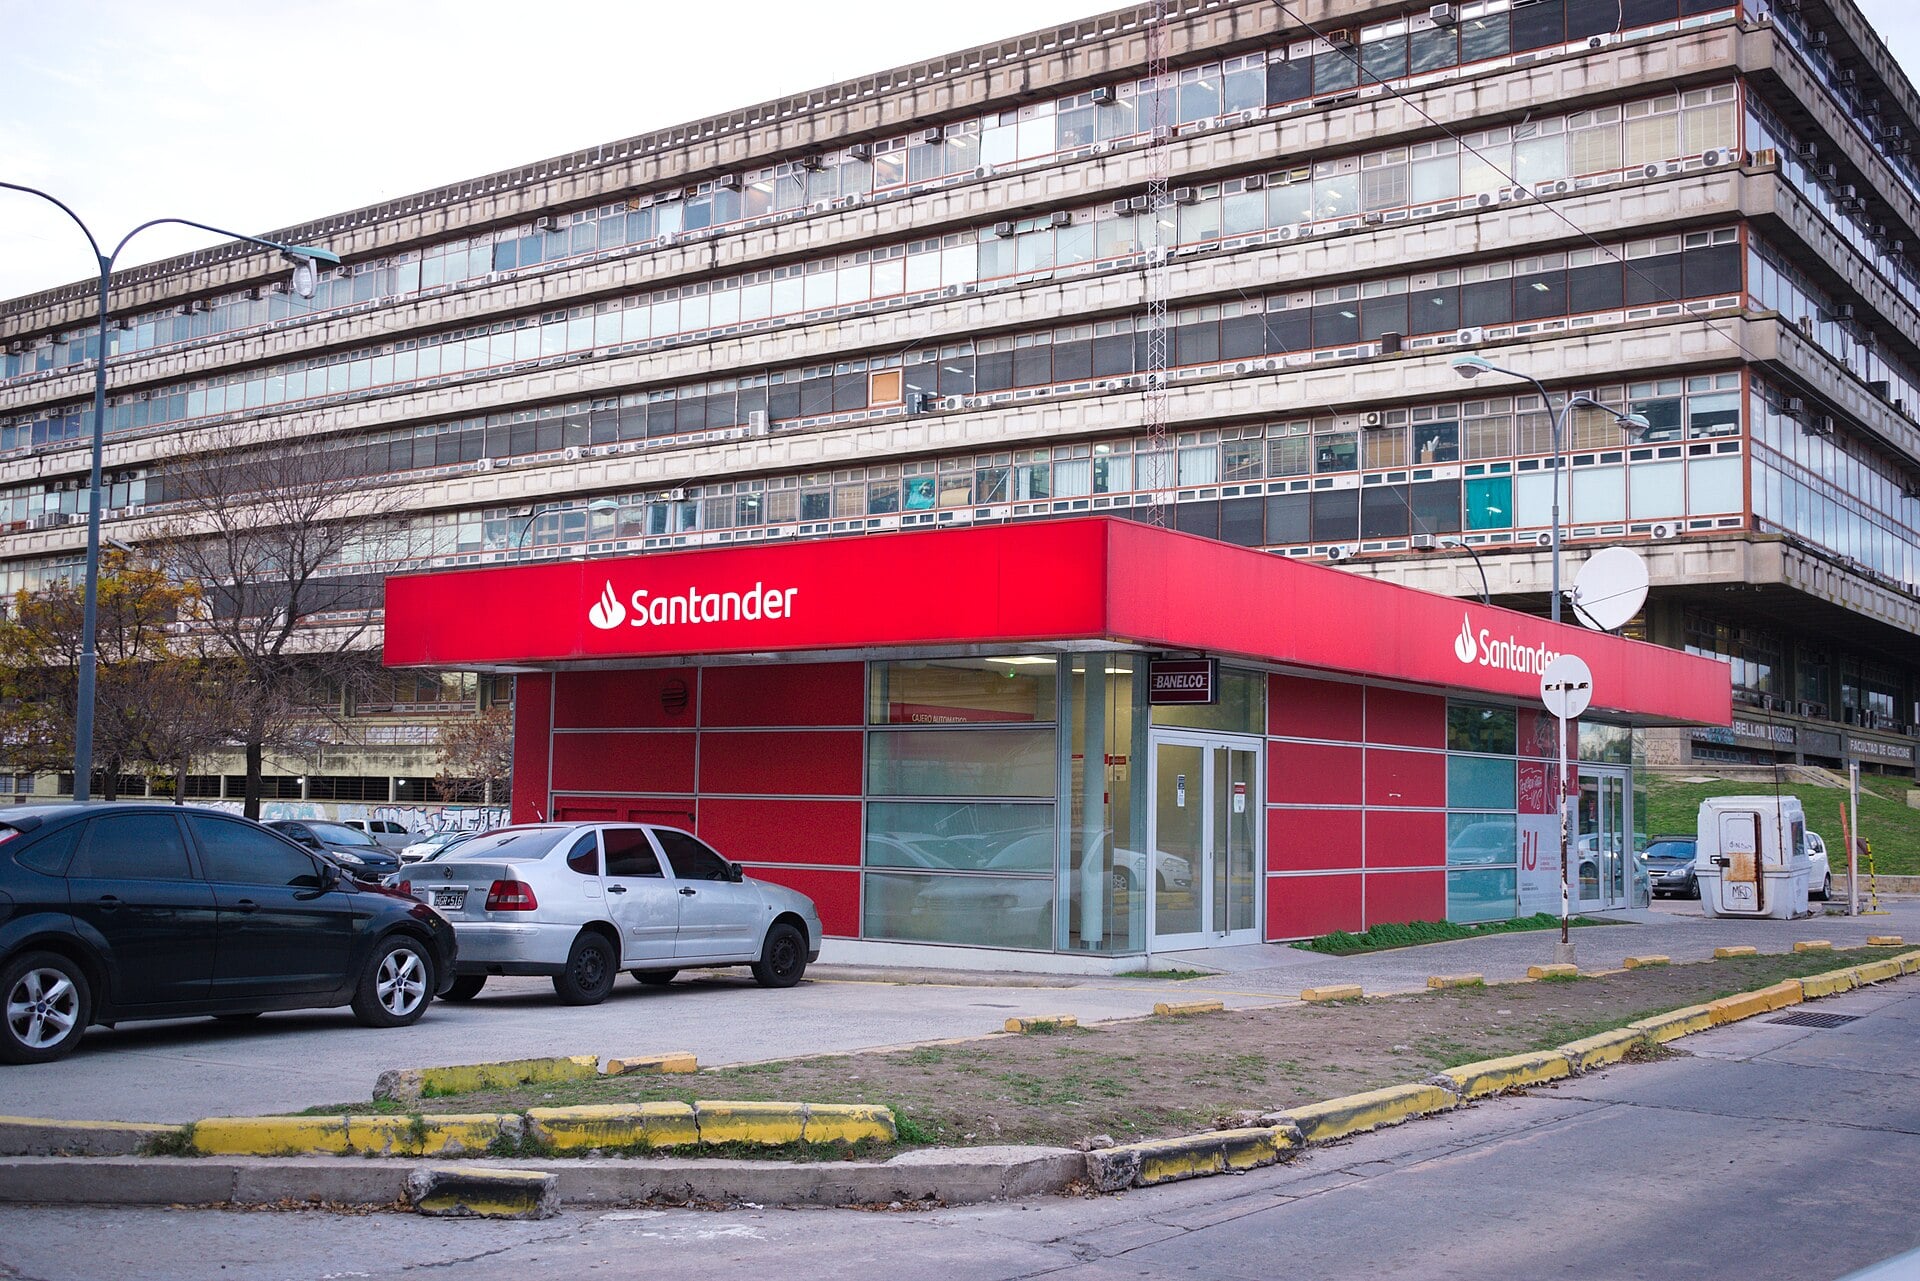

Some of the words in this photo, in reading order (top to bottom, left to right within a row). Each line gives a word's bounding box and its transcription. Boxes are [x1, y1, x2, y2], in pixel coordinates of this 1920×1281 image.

[630, 581, 799, 627] Santander
[1156, 674, 1204, 689] BANELCO
[911, 713, 932, 723] CAJERO
[1850, 740, 1878, 754] FACULTAD
[1879, 744, 1886, 755] DE
[1887, 746, 1910, 759] CIENCIAS
[450, 896, 463, 906] 516
